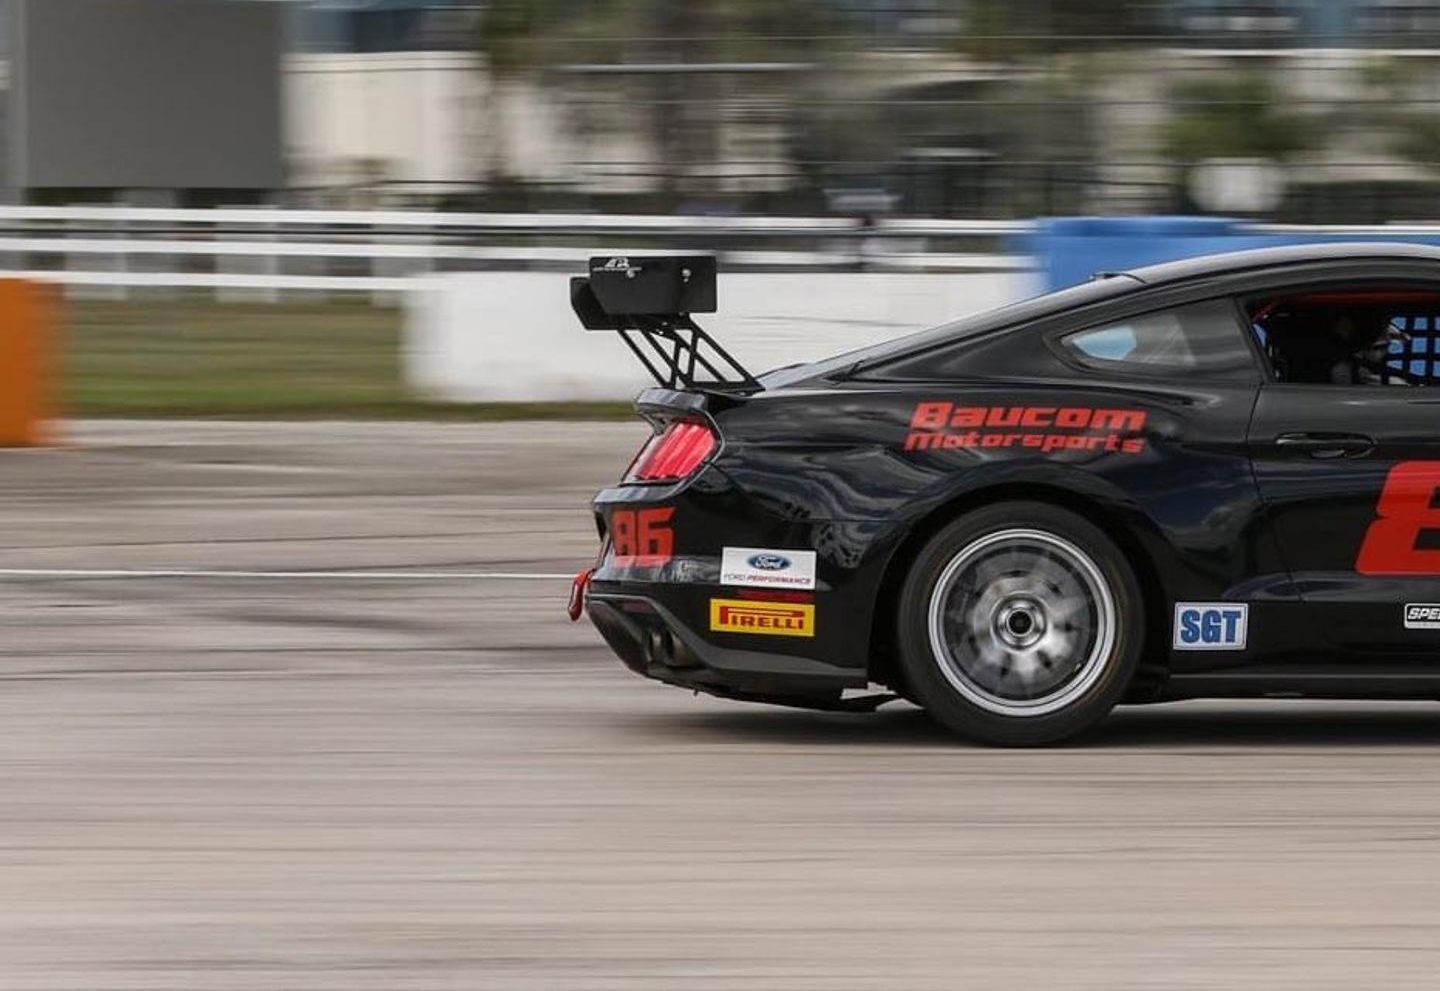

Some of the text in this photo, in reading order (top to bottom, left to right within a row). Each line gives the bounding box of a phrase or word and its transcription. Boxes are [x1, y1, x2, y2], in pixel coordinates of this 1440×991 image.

[909, 401, 1147, 431] Baucom
[904, 430, 1147, 454] Motorsports
[611, 506, 675, 569] 86
[751, 555, 787, 570] Ford
[719, 605, 806, 630] PIRELLI
[1180, 609, 1242, 644] SGT
